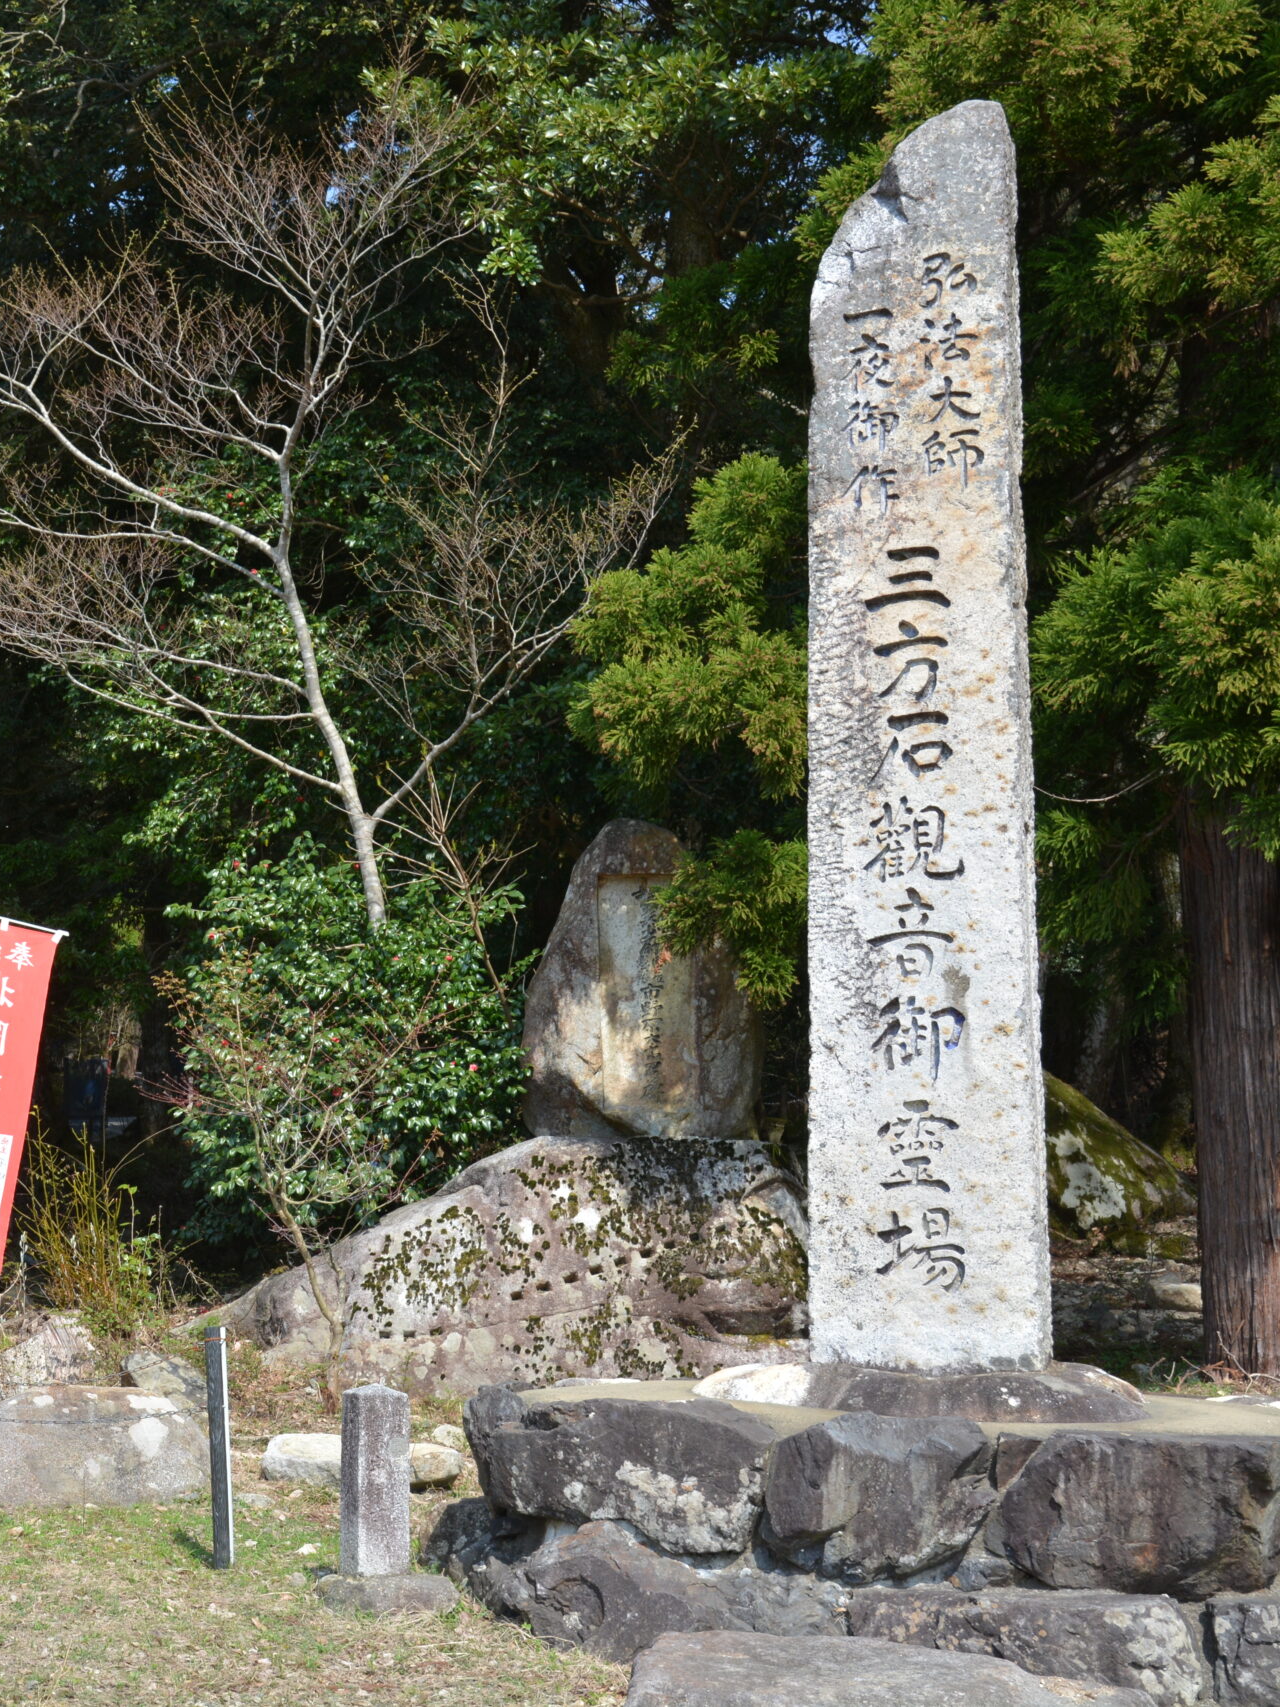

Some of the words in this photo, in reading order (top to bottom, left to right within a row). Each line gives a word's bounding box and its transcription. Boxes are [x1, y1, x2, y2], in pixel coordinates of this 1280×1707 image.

[841, 307, 901, 515] 一夜御作
[919, 251, 985, 489] 弘法大師
